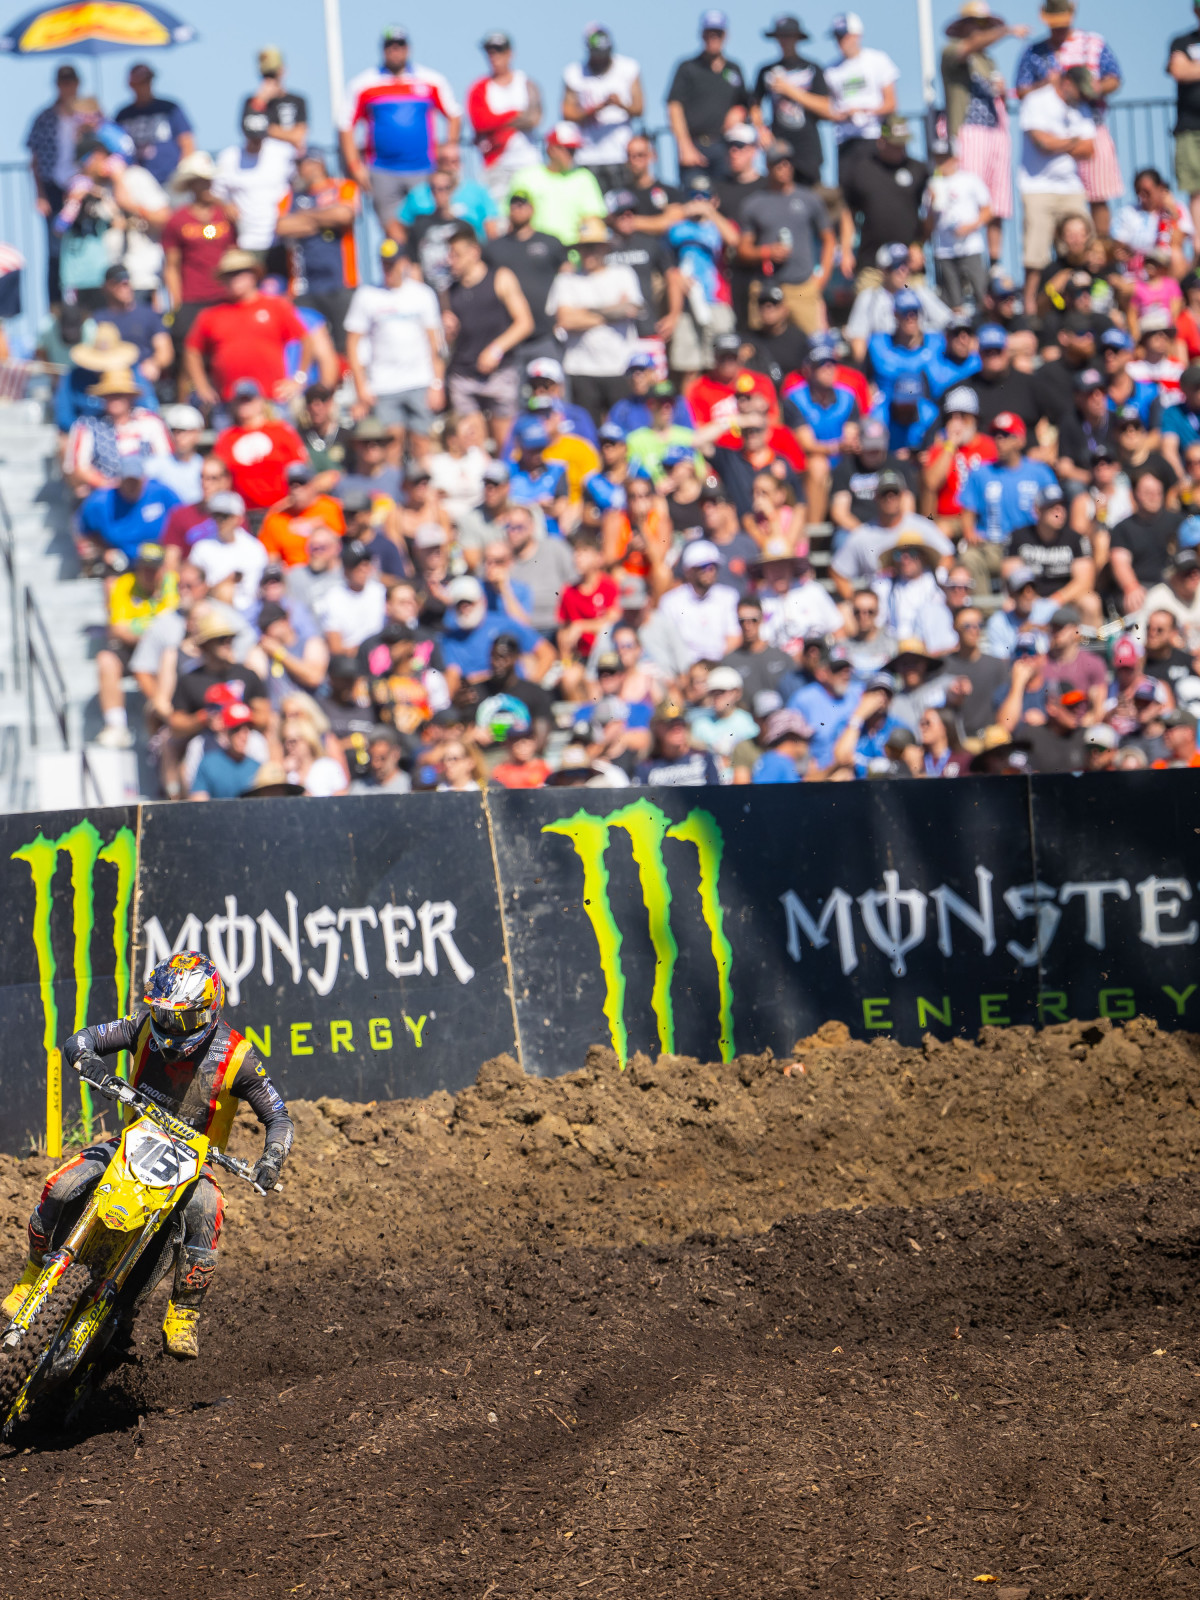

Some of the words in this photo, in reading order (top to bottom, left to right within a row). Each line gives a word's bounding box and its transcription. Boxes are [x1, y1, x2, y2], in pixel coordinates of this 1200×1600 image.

[778, 863, 1200, 977] MONSTE
[142, 889, 476, 1007] MONSTER
[863, 983, 1198, 1031] ENERGY
[244, 1014, 428, 1058] NERGY
[138, 1082, 206, 1115] PROGRIVE
